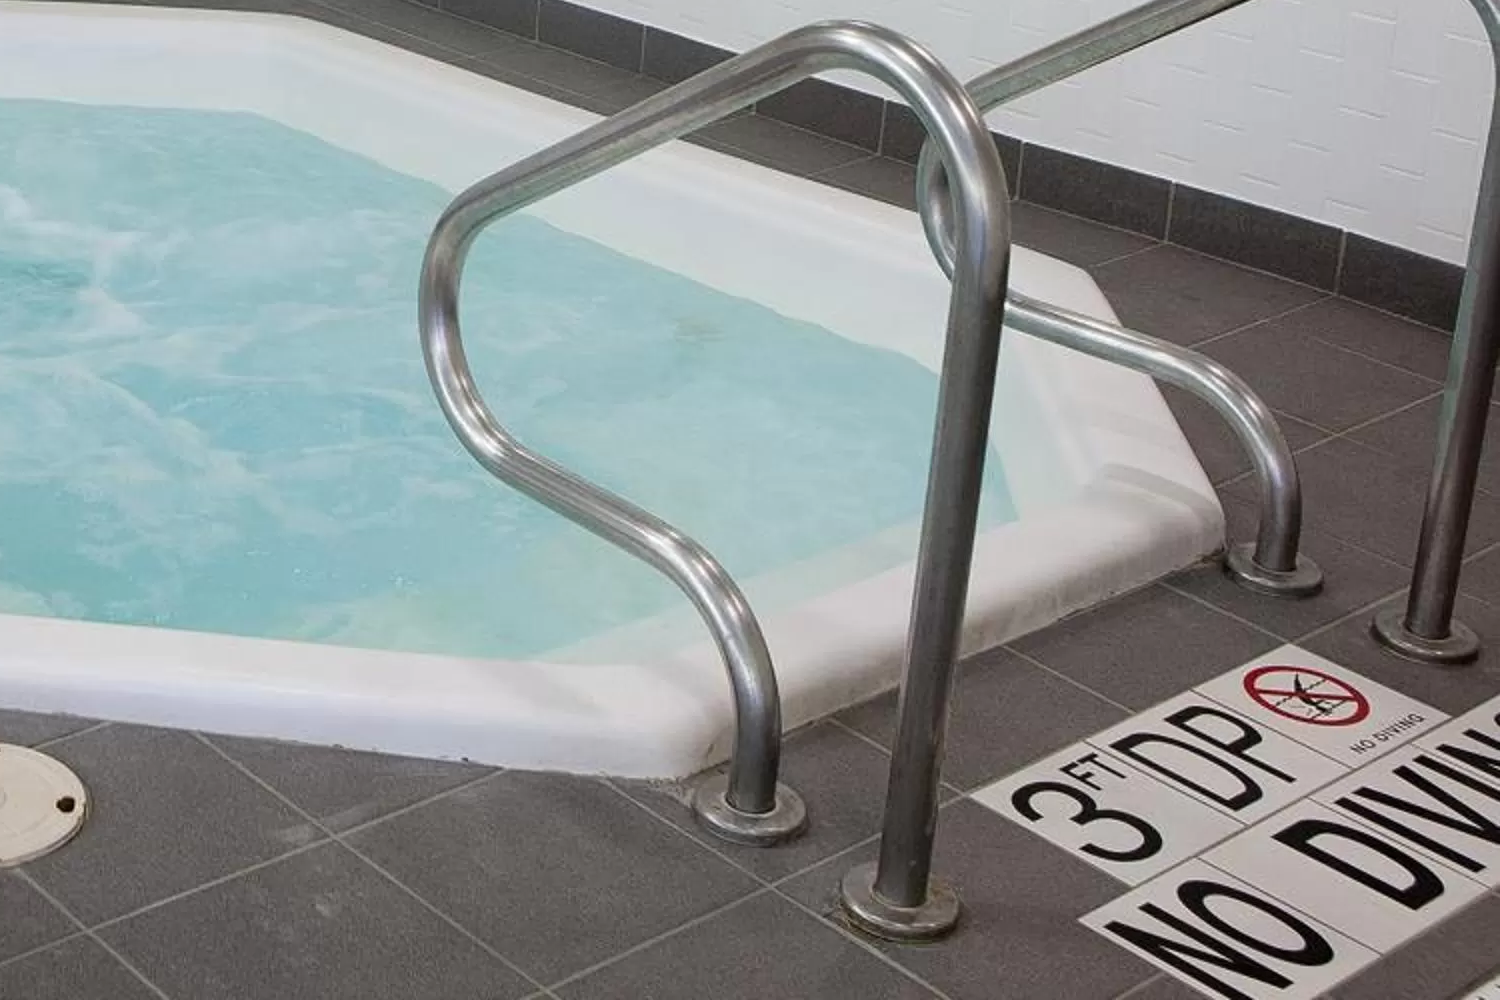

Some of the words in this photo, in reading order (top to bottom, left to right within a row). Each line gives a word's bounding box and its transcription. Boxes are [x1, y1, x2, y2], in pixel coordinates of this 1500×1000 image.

[1349, 739, 1376, 755] NO
[1371, 712, 1425, 742] DIVING
[1102, 879, 1335, 1000] NO
[1270, 711, 1500, 911] DIVI
